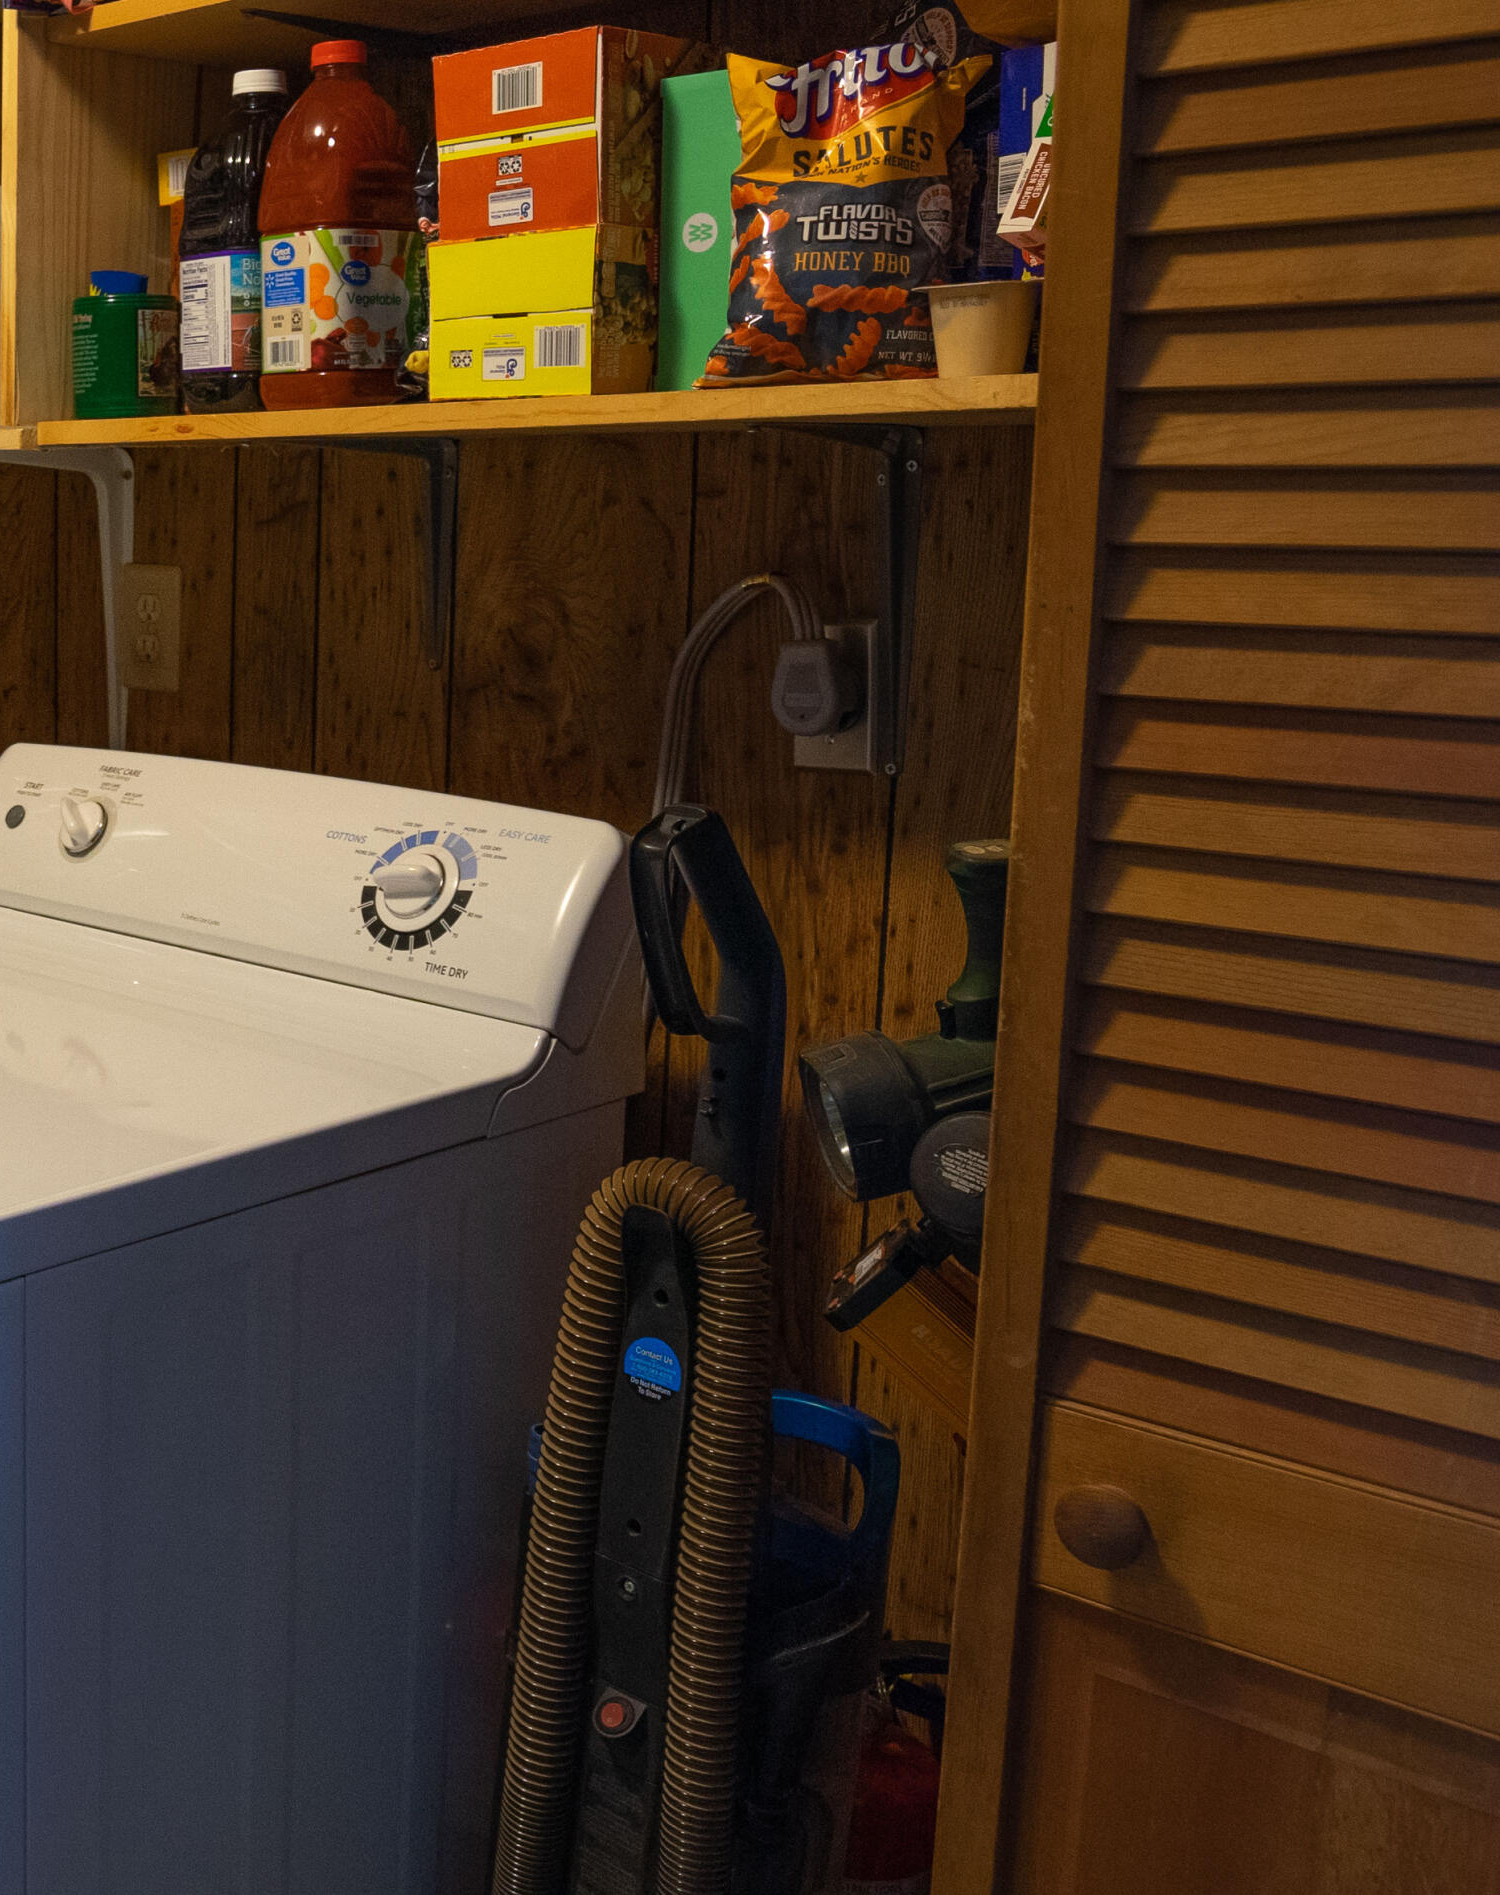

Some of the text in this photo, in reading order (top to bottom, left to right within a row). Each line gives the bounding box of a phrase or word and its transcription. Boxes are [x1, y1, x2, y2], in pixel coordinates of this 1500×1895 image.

[793, 125, 935, 178] SALUTES
[1017, 151, 1048, 211] CHICKEN BACON
[819, 203, 897, 220] FLAVOR
[796, 215, 914, 246] TWISTS
[273, 248, 291, 257] Great
[344, 265, 366, 276] Great
[793, 250, 912, 278] HONEY BBQ
[346, 292, 403, 308] Vegetable
[884, 329, 928, 342] FLAVORED
[99, 765, 143, 778] FABRIC CARE
[23, 781, 45, 790] START
[325, 830, 368, 845] COTTONS
[498, 828, 552, 845] EASY CARE
[424, 961, 470, 980] TIME DRY
[635, 1345, 674, 1366] Contact Us
